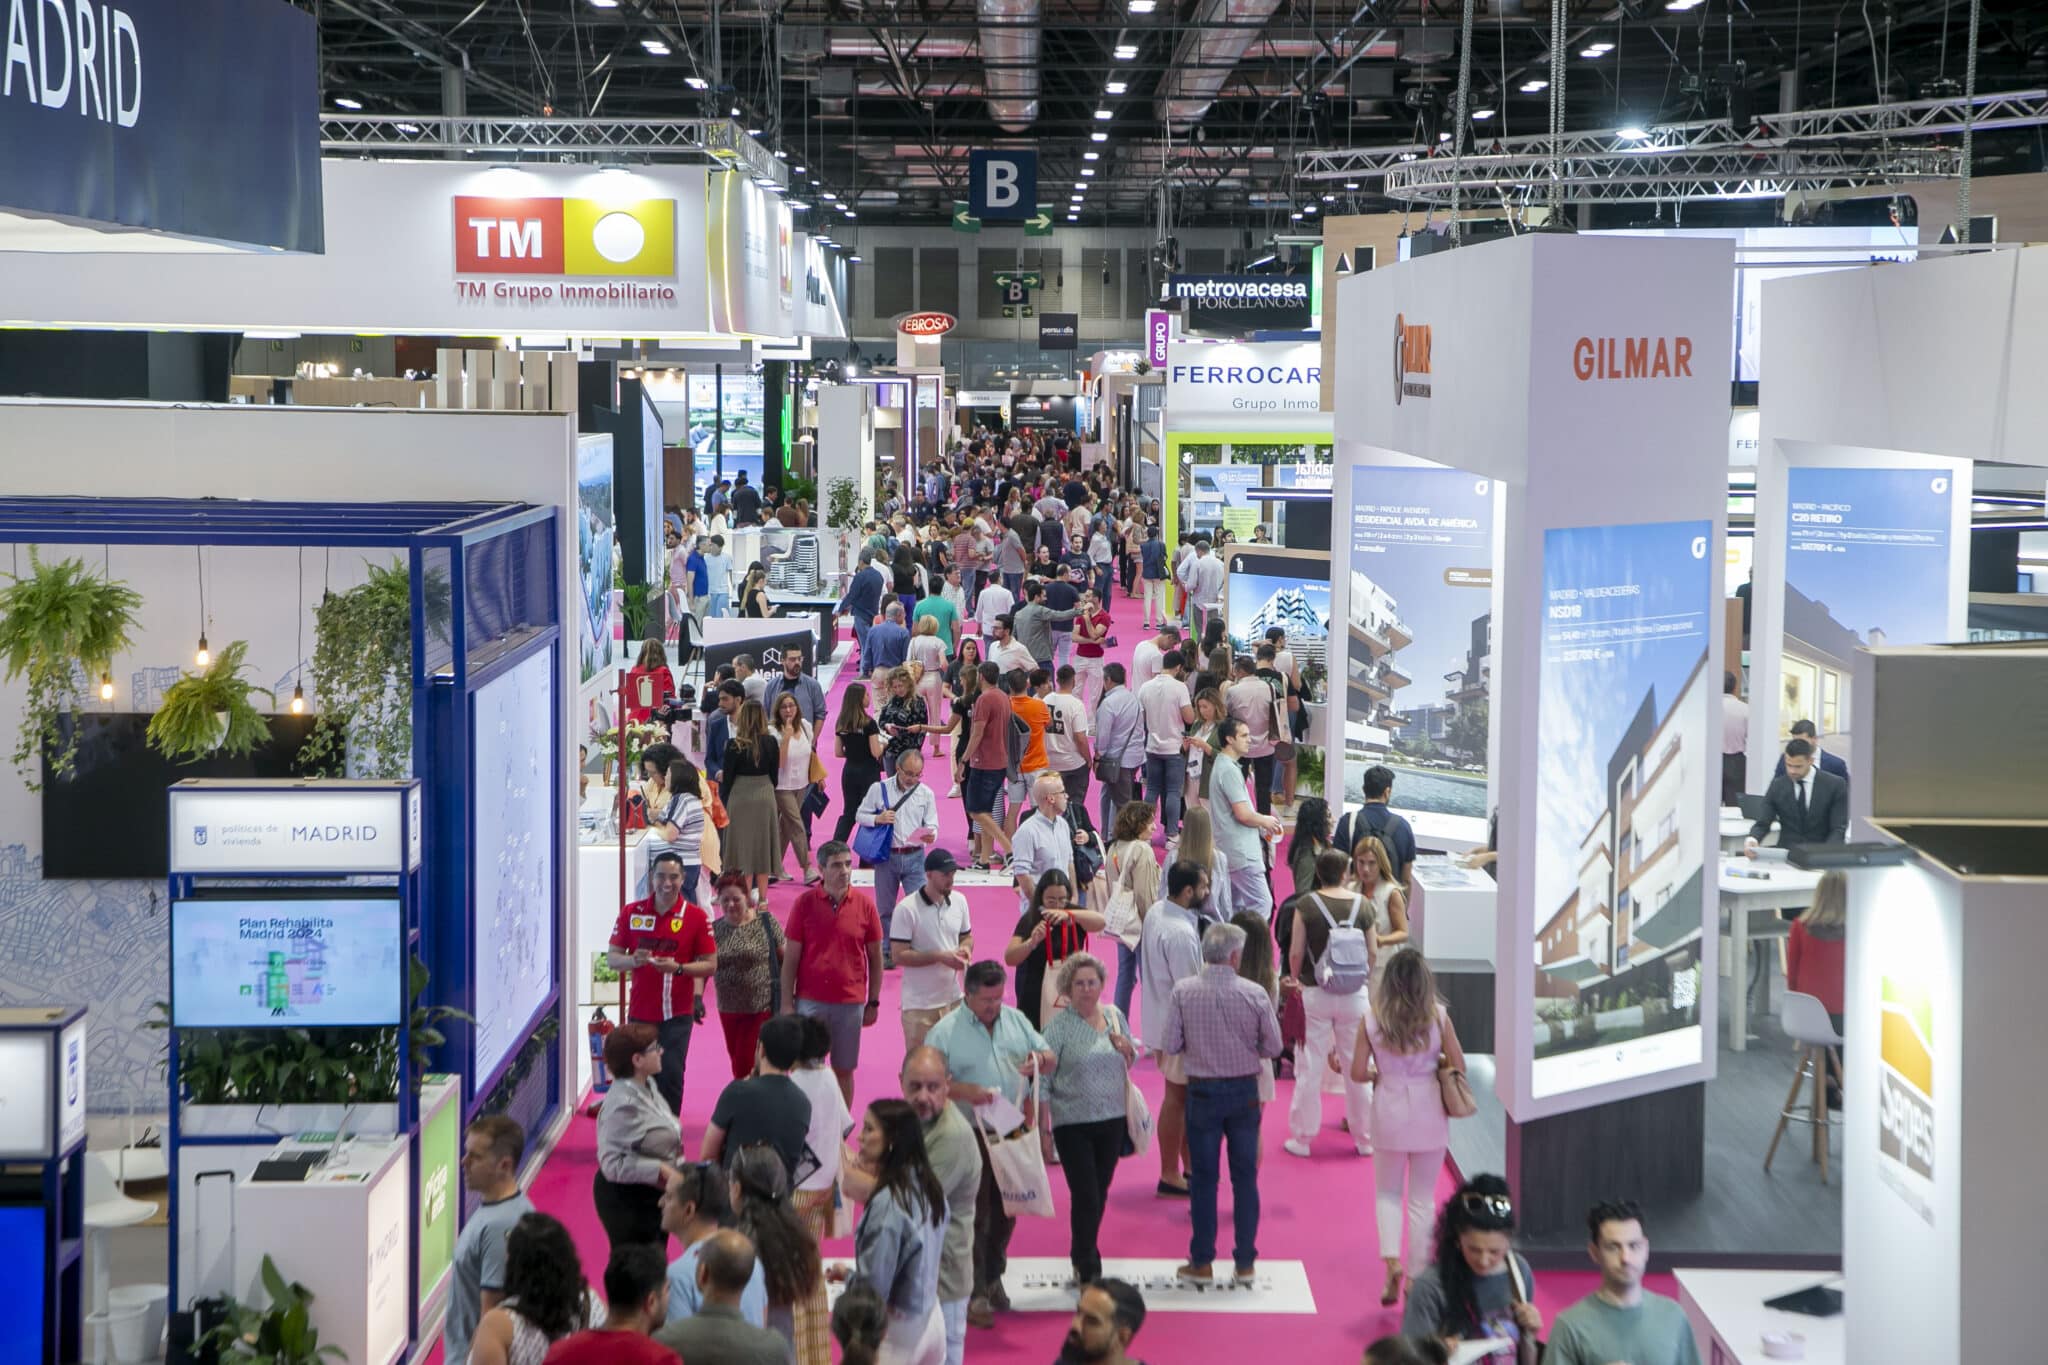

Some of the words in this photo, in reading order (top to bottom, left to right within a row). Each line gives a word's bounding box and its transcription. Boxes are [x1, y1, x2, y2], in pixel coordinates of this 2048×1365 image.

[986, 160, 1020, 208] B
[468, 218, 543, 258] TM
[456, 282, 486, 298] TM
[494, 282, 553, 302] Grupo
[560, 283, 674, 301] Inmobiliario
[1009, 281, 1023, 301] B
[1176, 279, 1308, 298] metrovacesa
[1197, 296, 1305, 310] PORCELANOSA
[905, 317, 950, 332] EBROSA
[1155, 322, 1167, 362] GRUPO
[1573, 336, 1693, 381] GILMAR
[1172, 366, 1321, 385] FERROCAR
[1232, 398, 1278, 412] Grupo
[1354, 514, 1402, 526] RESIDENCIAL
[222, 837, 262, 846] vivienda
[292, 825, 377, 842] MADRID
[239, 917, 267, 929] Plan
[270, 917, 334, 930] Rehabilita
[239, 928, 285, 940] Madrid
[287, 929, 323, 939] 2024
